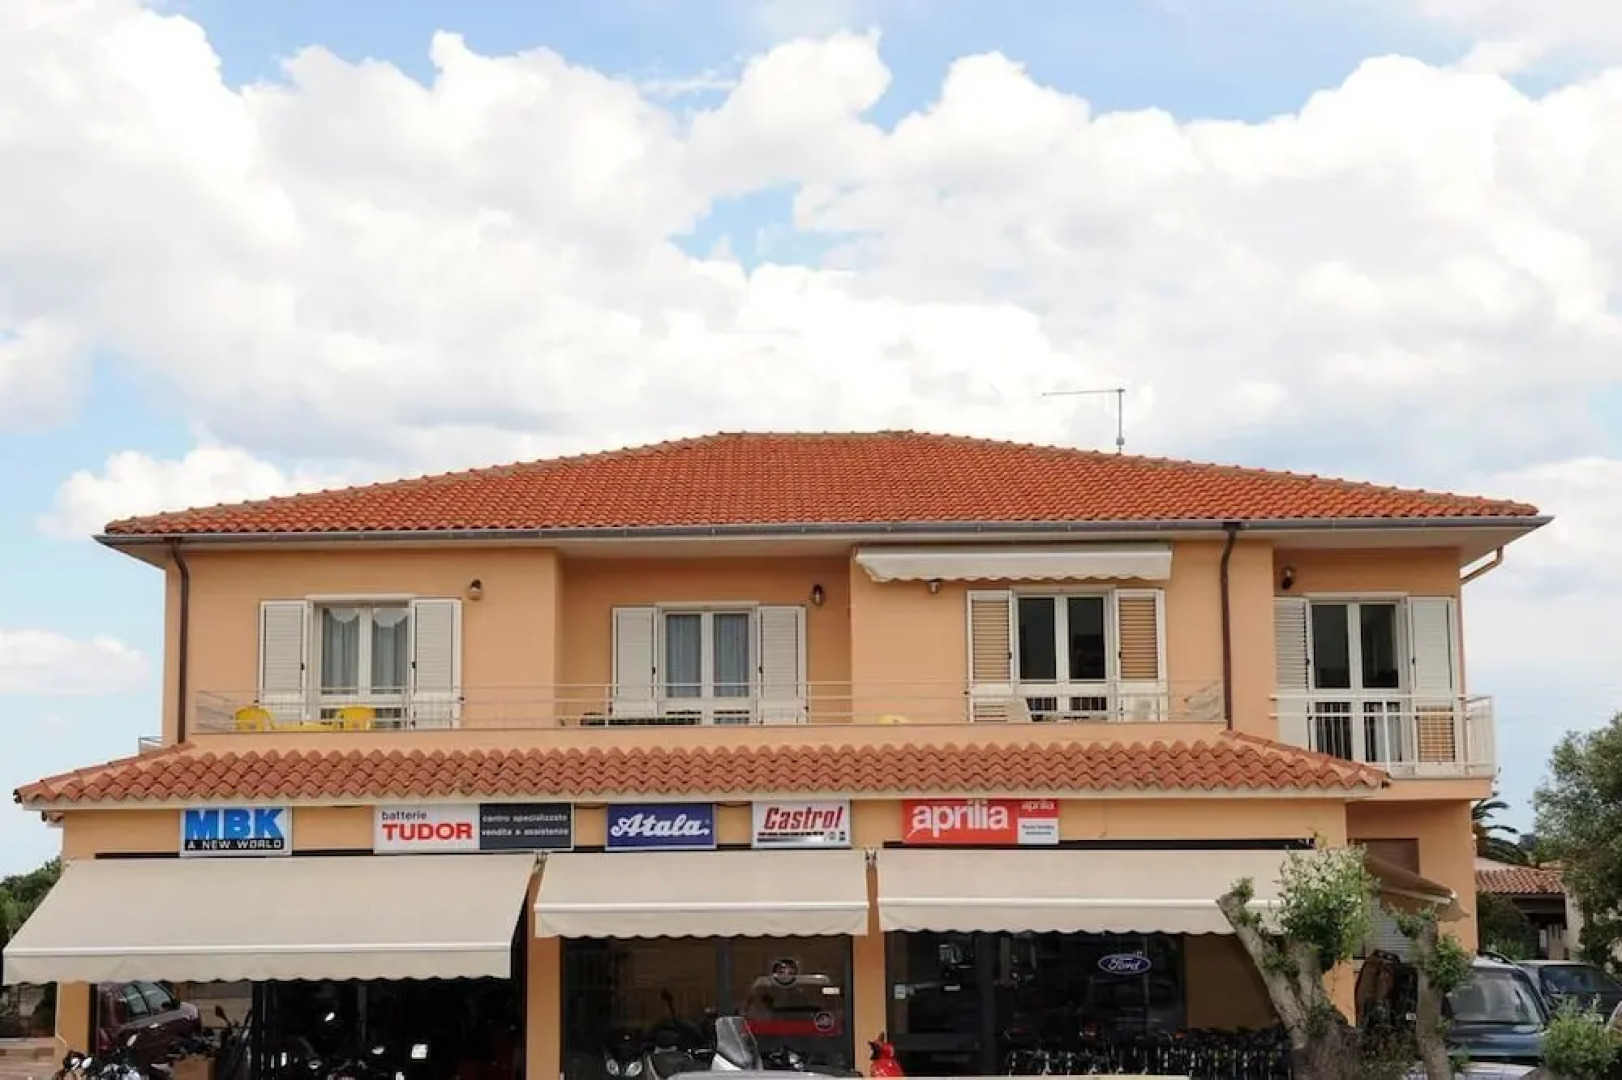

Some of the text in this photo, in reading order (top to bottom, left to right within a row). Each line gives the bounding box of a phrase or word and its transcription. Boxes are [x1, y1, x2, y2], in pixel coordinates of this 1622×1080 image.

[185, 809, 284, 839] MBK
[381, 810, 428, 821] batterie
[609, 813, 710, 837] Atala
[763, 806, 844, 831] Castrol
[907, 799, 1010, 838] aprilia
[382, 823, 474, 840] TUDOR
[187, 839, 282, 849] A NEW WORLD
[1107, 955, 1141, 971] Ford
